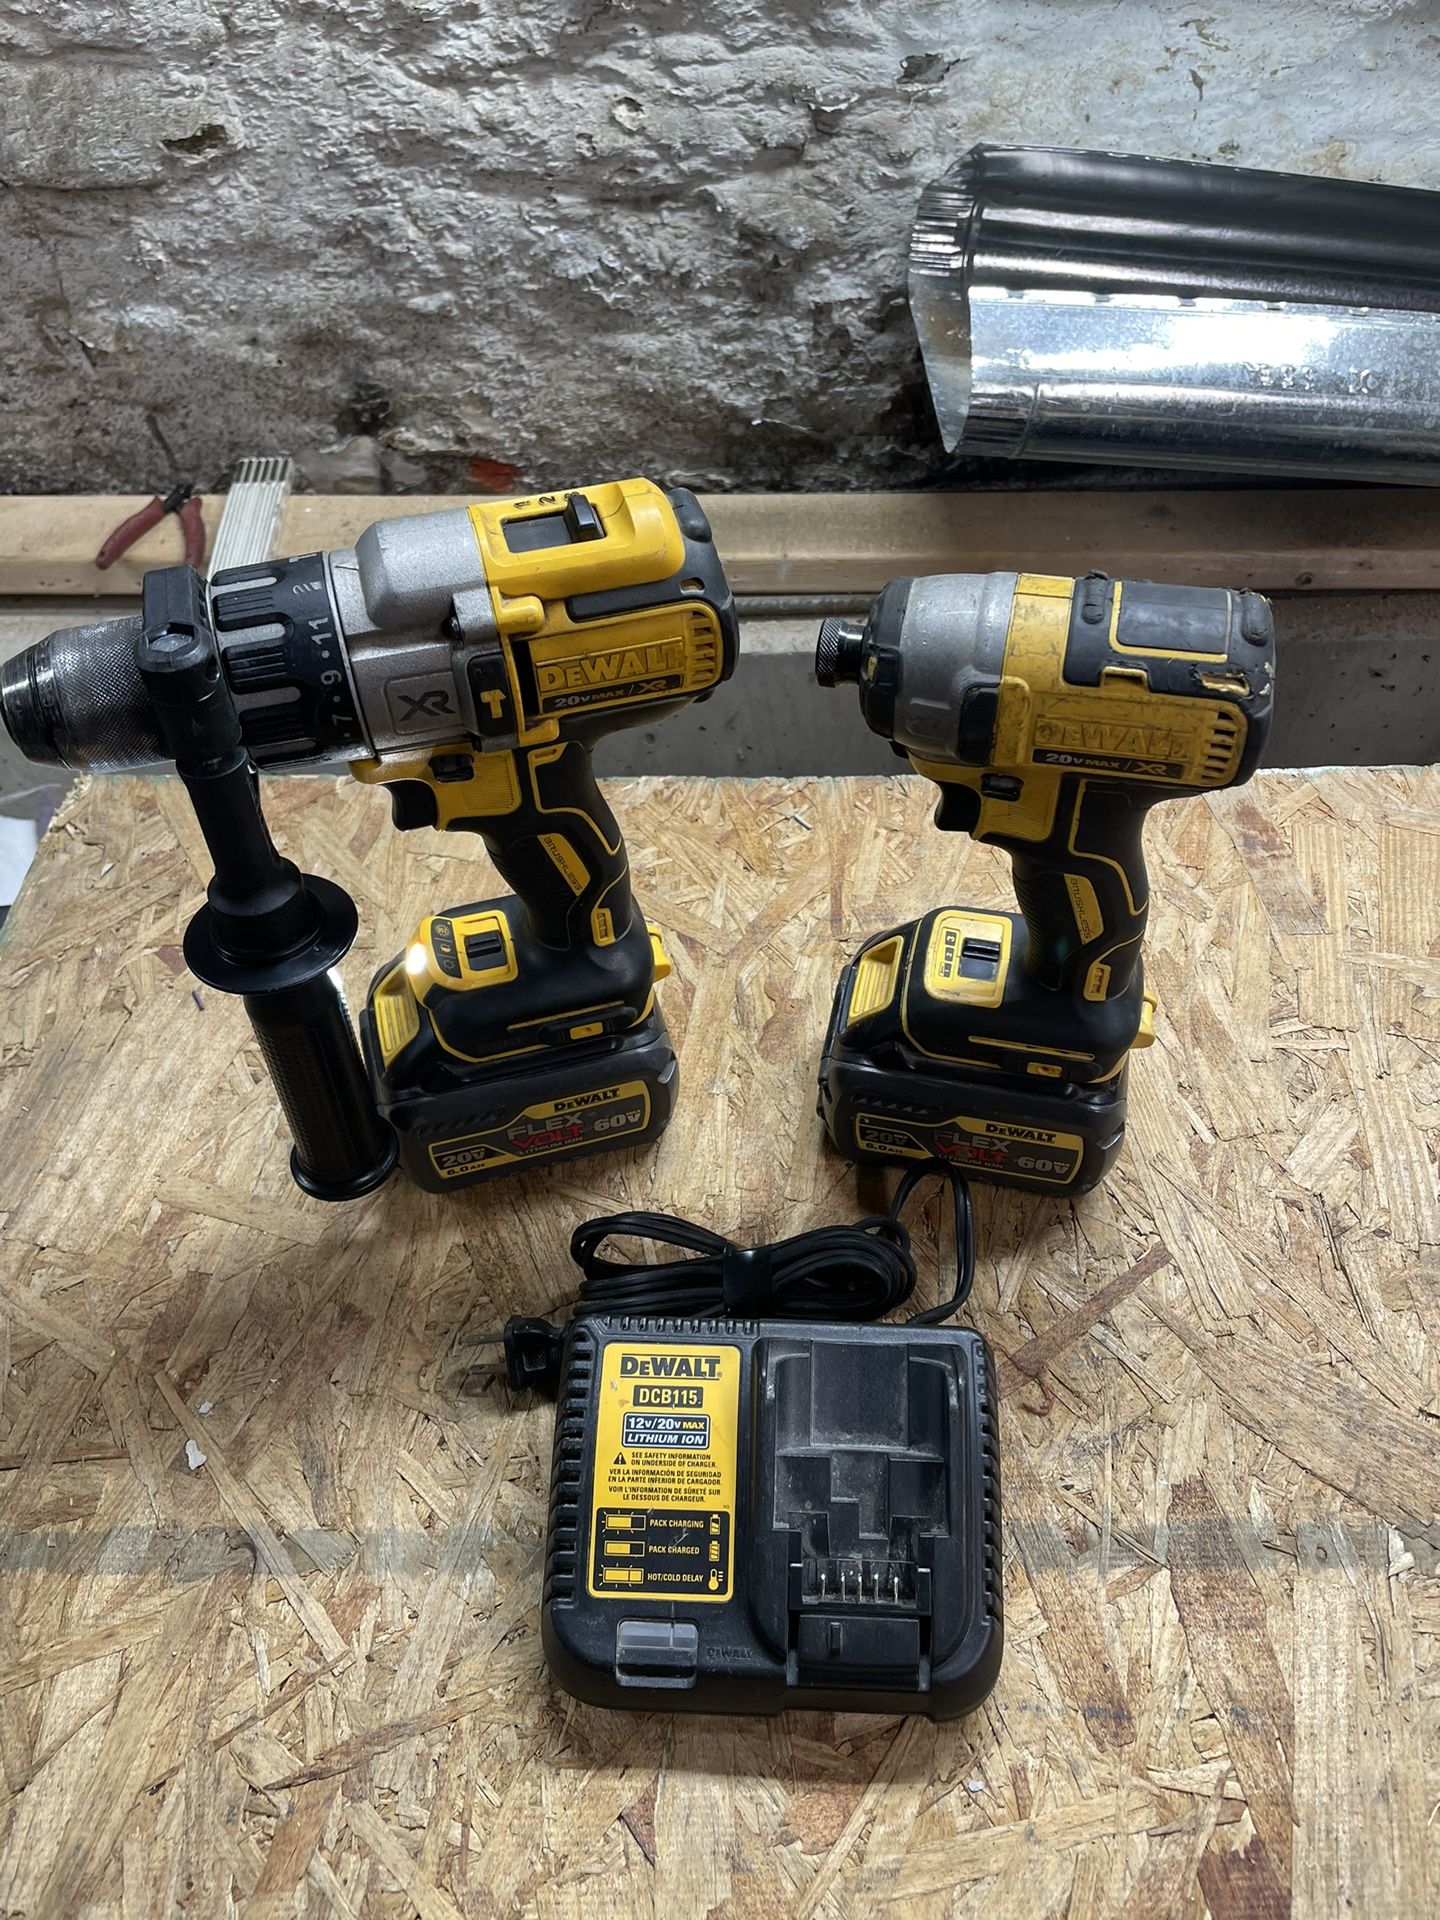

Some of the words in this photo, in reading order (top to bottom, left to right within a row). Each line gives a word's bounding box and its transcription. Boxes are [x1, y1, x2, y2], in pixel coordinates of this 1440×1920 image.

[538, 496, 556, 506] 2
[308, 617, 332, 645] 11
[320, 669, 342, 685] 9
[538, 644, 683, 692] DEWALT
[592, 689, 625, 700] MAX
[638, 680, 667, 694] XR
[397, 690, 456, 722] XR
[332, 713, 353, 726] 7
[1085, 759, 1121, 769] MAX
[1134, 762, 1168, 775] XR
[544, 836, 582, 891] BRUSHLESS
[1070, 879, 1091, 940] BRUSHLESS
[554, 1088, 620, 1112] DEWALT
[507, 1111, 584, 1141] FLEX
[593, 1112, 641, 1132] 60V
[512, 1123, 584, 1149] VOLT
[865, 1129, 907, 1145] 20V
[933, 1129, 1011, 1152] FLEX
[985, 1123, 1056, 1144] DEWALT
[442, 1150, 485, 1168] 20V
[1017, 1156, 1070, 1174] 60V
[621, 1356, 720, 1378] DEWALT
[639, 1388, 698, 1405] DCB115
[682, 1421, 705, 1430] MAX
[627, 1433, 678, 1445] LITHIUM
[680, 1436, 704, 1445] ION
[632, 1469, 675, 1477] INFORMACIÓN
[625, 1486, 672, 1494] L'INFORMATION
[650, 1519, 667, 1527] PACK
[669, 1519, 704, 1528] CHARGING
[648, 1545, 666, 1553] PACK
[668, 1546, 699, 1554] CHARGED
[647, 1573, 681, 1581] HOT/COLD
[682, 1574, 703, 1582] DELAY
